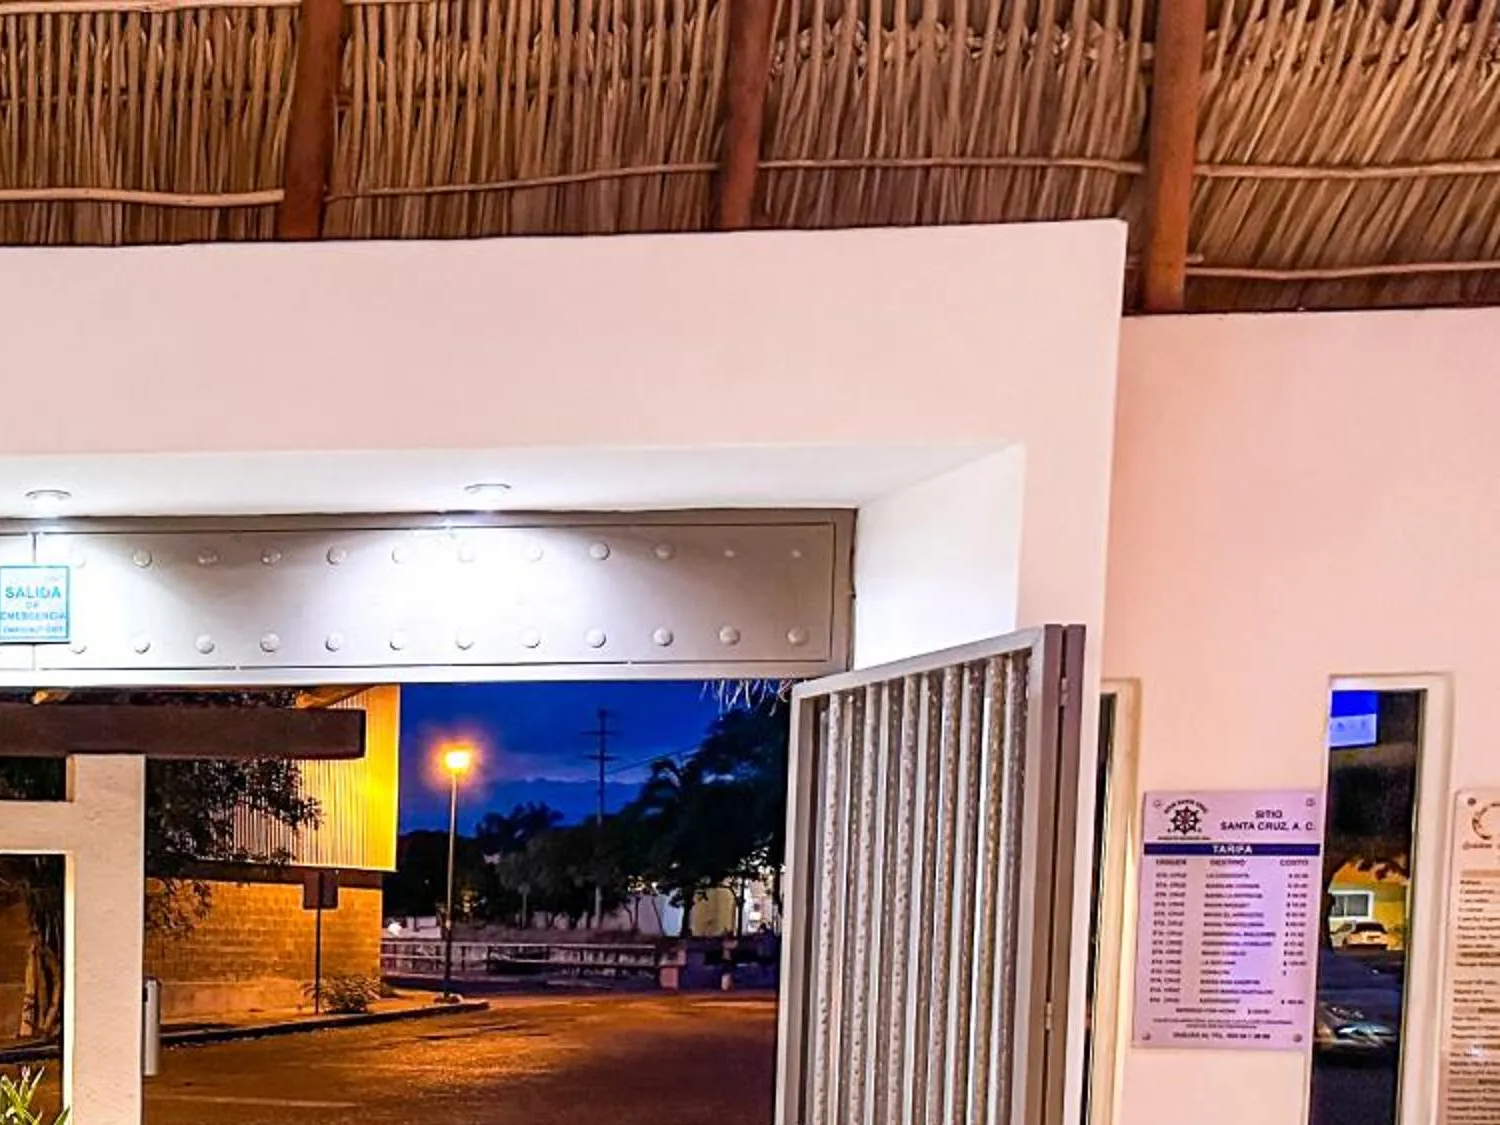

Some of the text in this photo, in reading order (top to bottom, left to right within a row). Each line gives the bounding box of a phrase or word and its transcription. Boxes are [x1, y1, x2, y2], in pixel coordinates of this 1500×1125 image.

[5, 586, 62, 599] SALIDA
[1255, 809, 1283, 819] SITIO
[1220, 821, 1255, 831] SANTA
[1211, 845, 1253, 855] TARIFA
